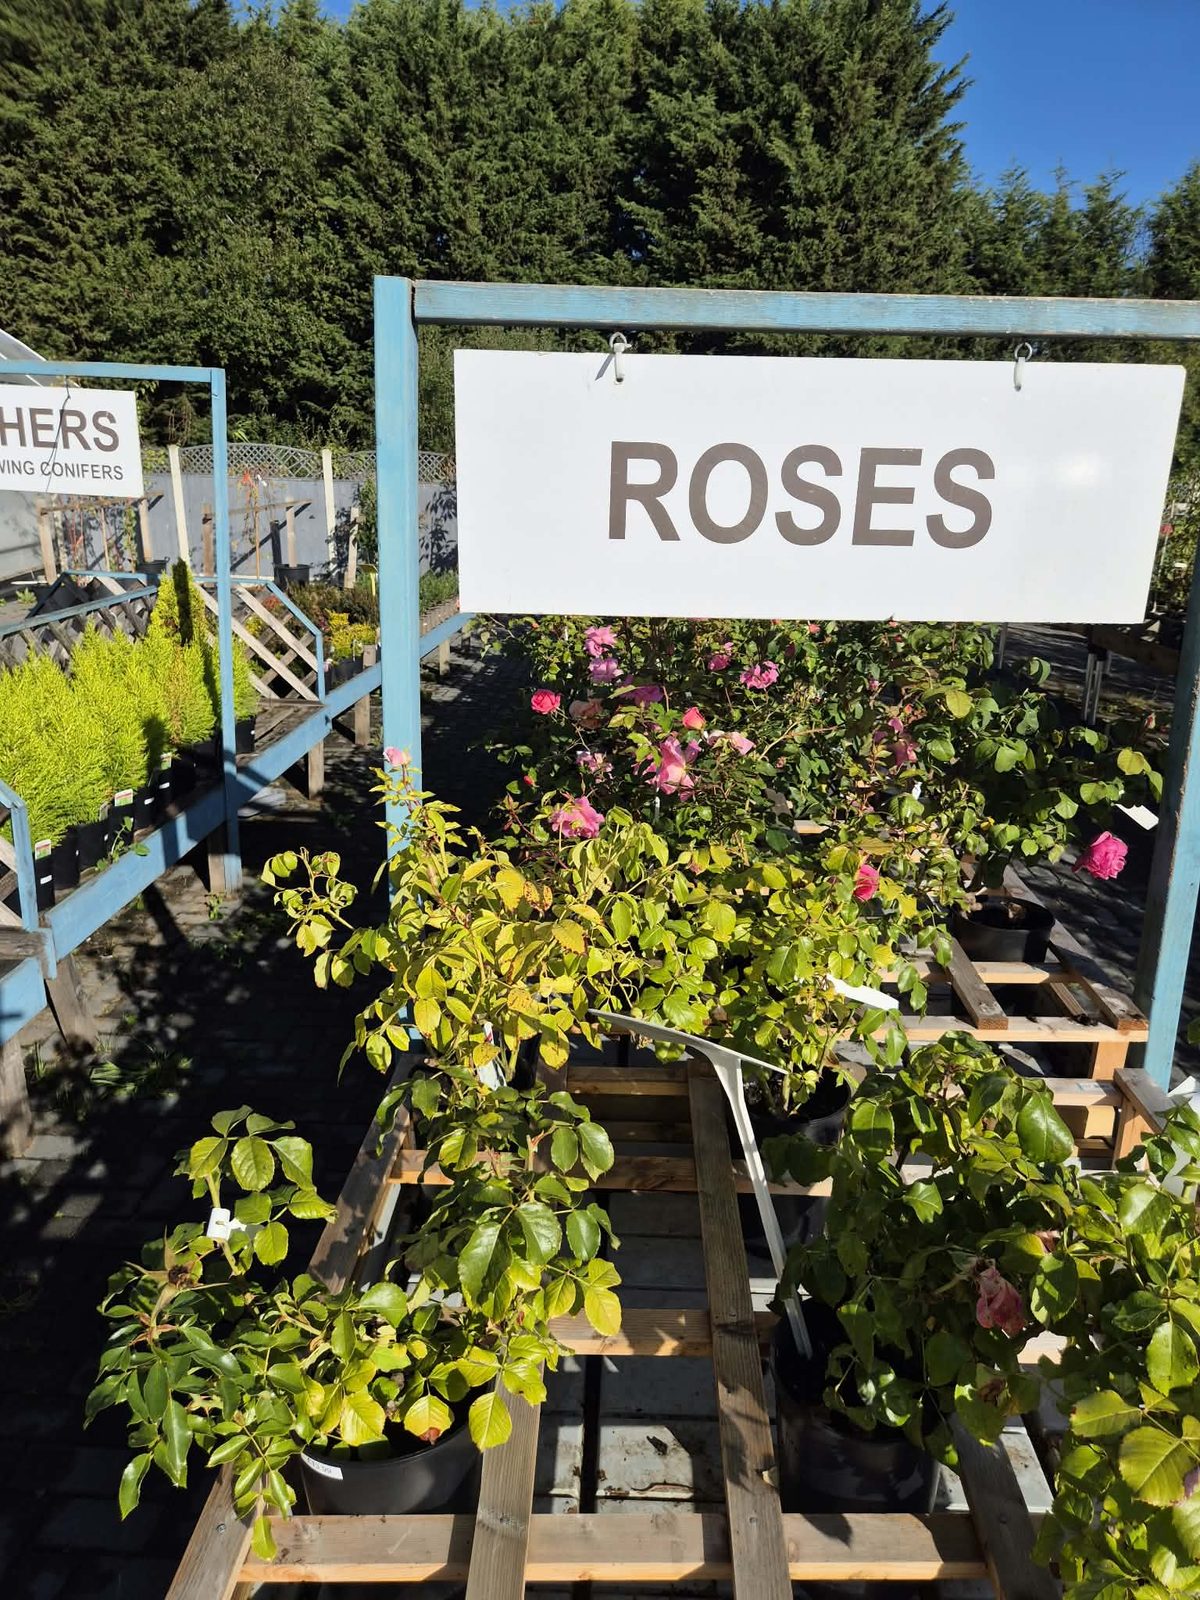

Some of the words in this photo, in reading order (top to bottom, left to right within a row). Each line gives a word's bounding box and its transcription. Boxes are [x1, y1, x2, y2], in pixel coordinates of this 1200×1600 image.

[0, 406, 119, 452] HERS
[40, 461, 123, 480] CONIFERS
[609, 441, 994, 549] ROSES
